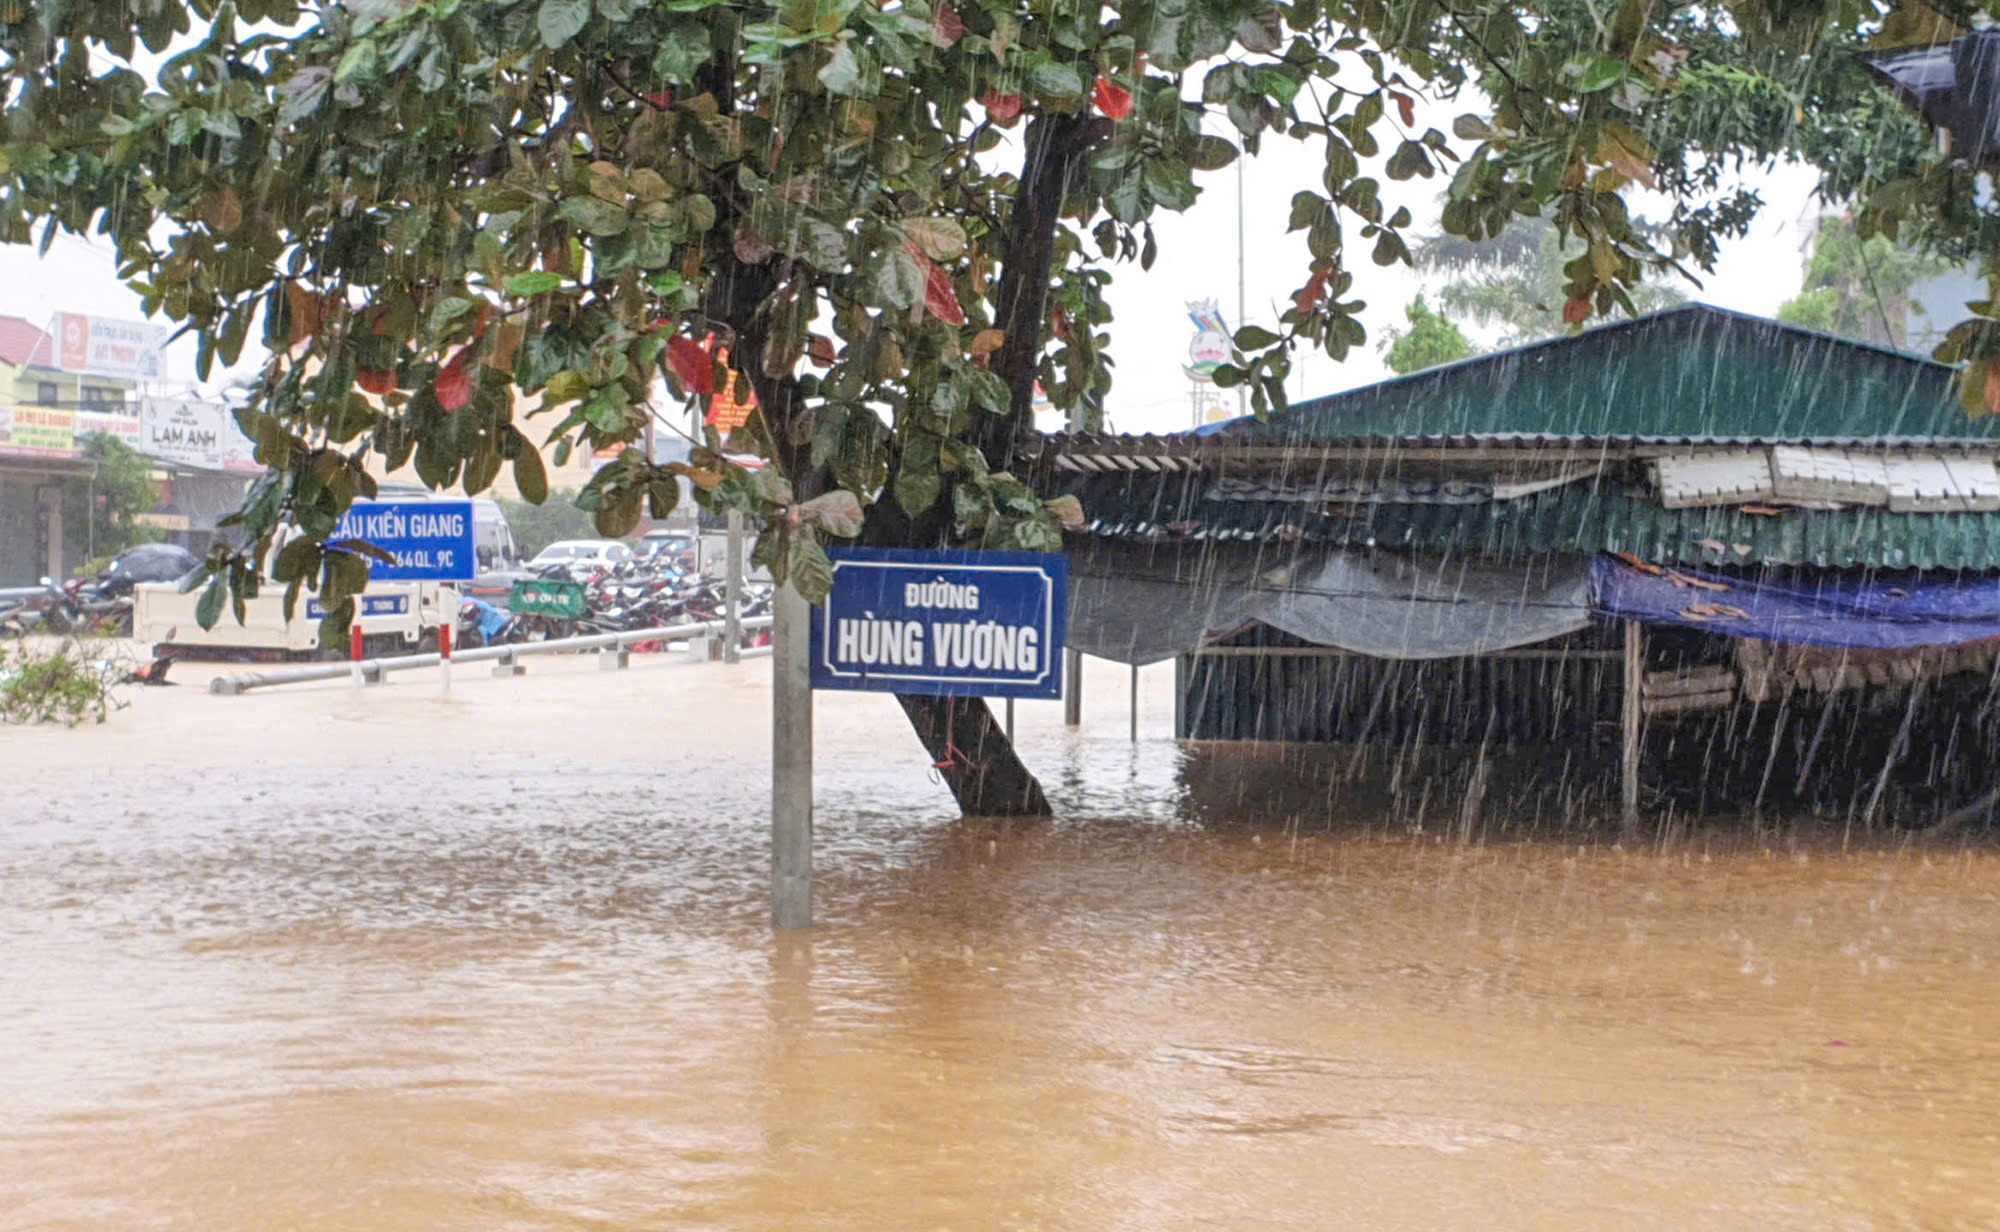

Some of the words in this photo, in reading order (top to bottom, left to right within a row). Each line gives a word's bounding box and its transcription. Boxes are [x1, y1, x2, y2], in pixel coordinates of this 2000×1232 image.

[152, 426, 183, 443] LAM
[186, 429, 216, 447] ANH
[367, 506, 405, 538] KIẾN
[411, 514, 464, 538] GIANG
[905, 576, 979, 610] ĐƯỜNG
[837, 611, 924, 666] HÙNG
[932, 619, 1039, 673] VƯƠNG
